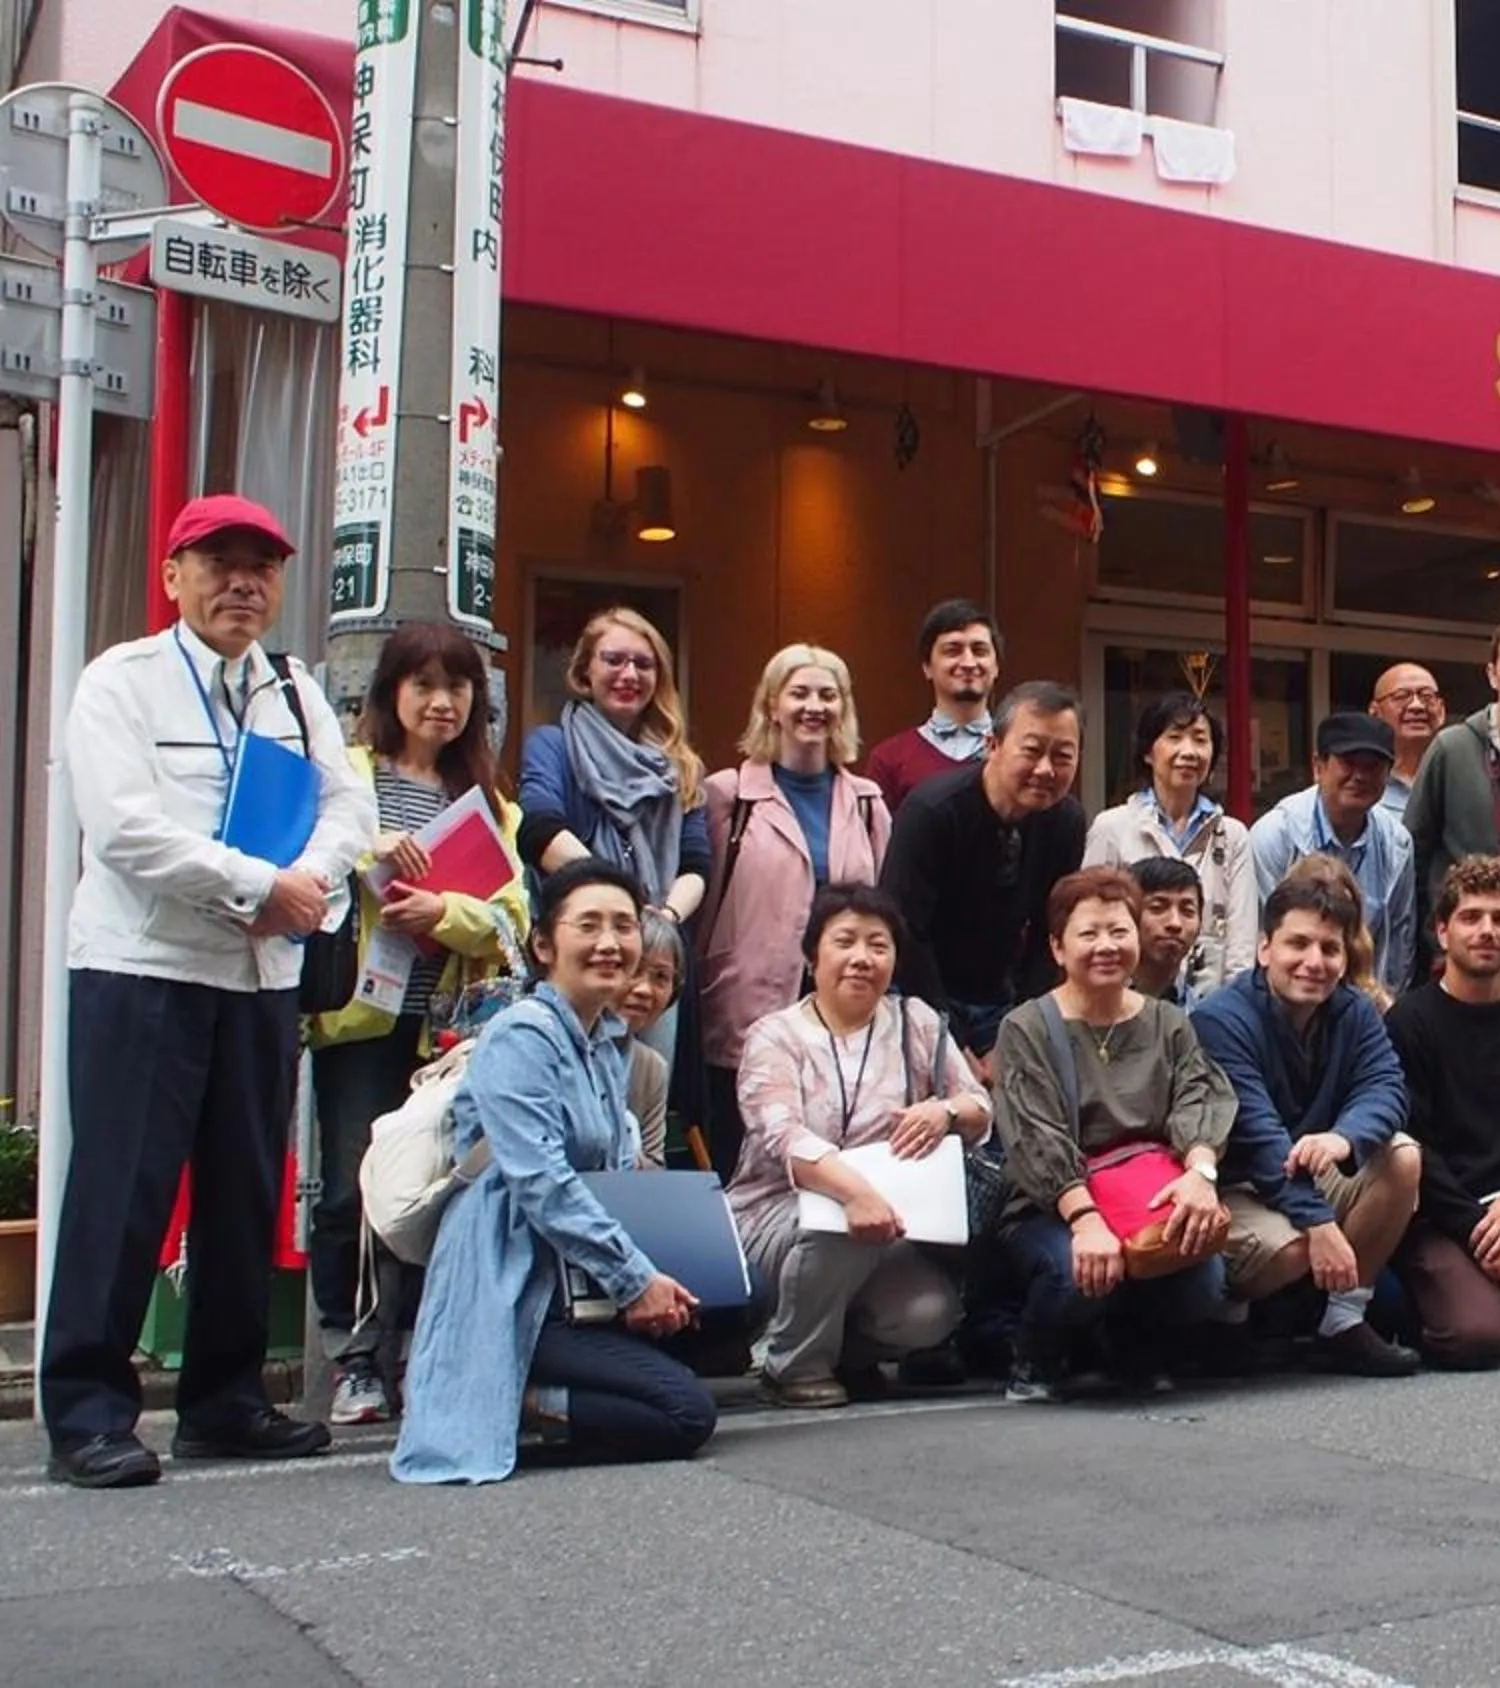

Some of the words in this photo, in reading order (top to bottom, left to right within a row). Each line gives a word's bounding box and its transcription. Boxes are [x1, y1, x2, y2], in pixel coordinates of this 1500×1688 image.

[165, 235, 332, 304] 自転車を除く
[349, 212, 388, 377] 消化器科
